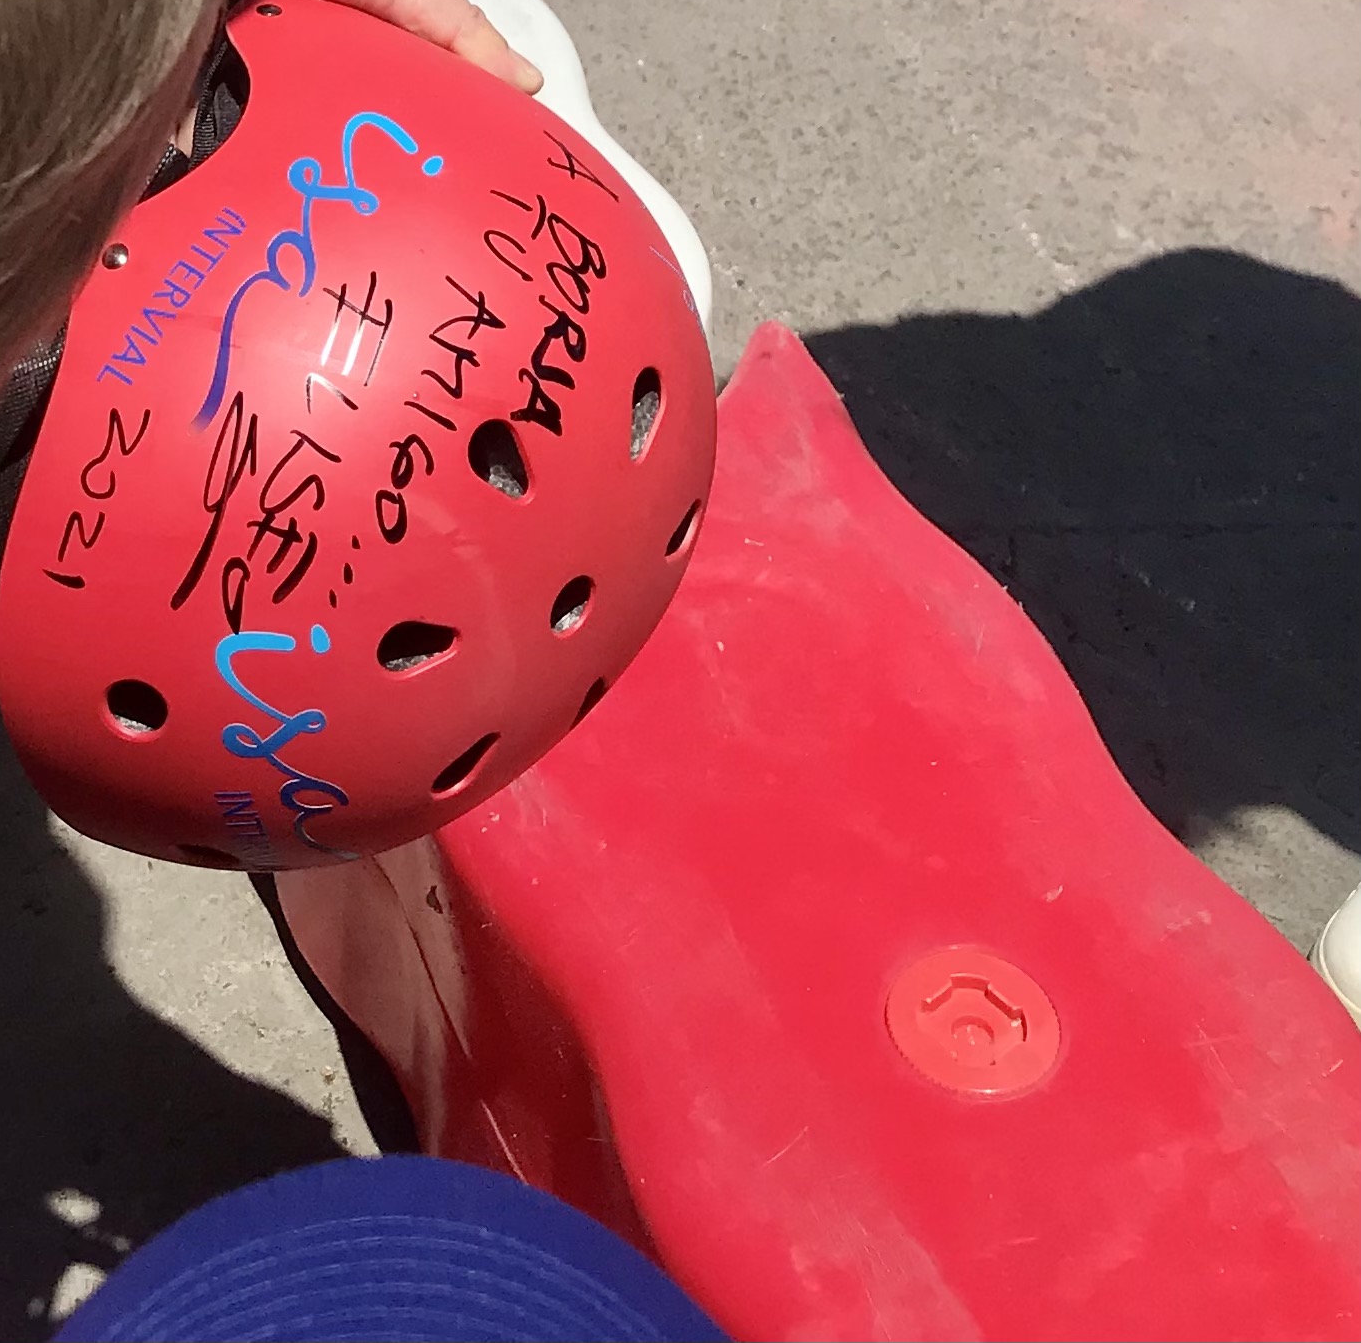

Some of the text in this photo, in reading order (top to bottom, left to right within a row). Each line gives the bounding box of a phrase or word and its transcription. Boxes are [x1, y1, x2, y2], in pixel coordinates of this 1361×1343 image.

[96, 207, 248, 386] INTERVIAL
[188, 112, 444, 436] isa
[43, 408, 150, 589] 2021
[216, 623, 358, 861] isa
